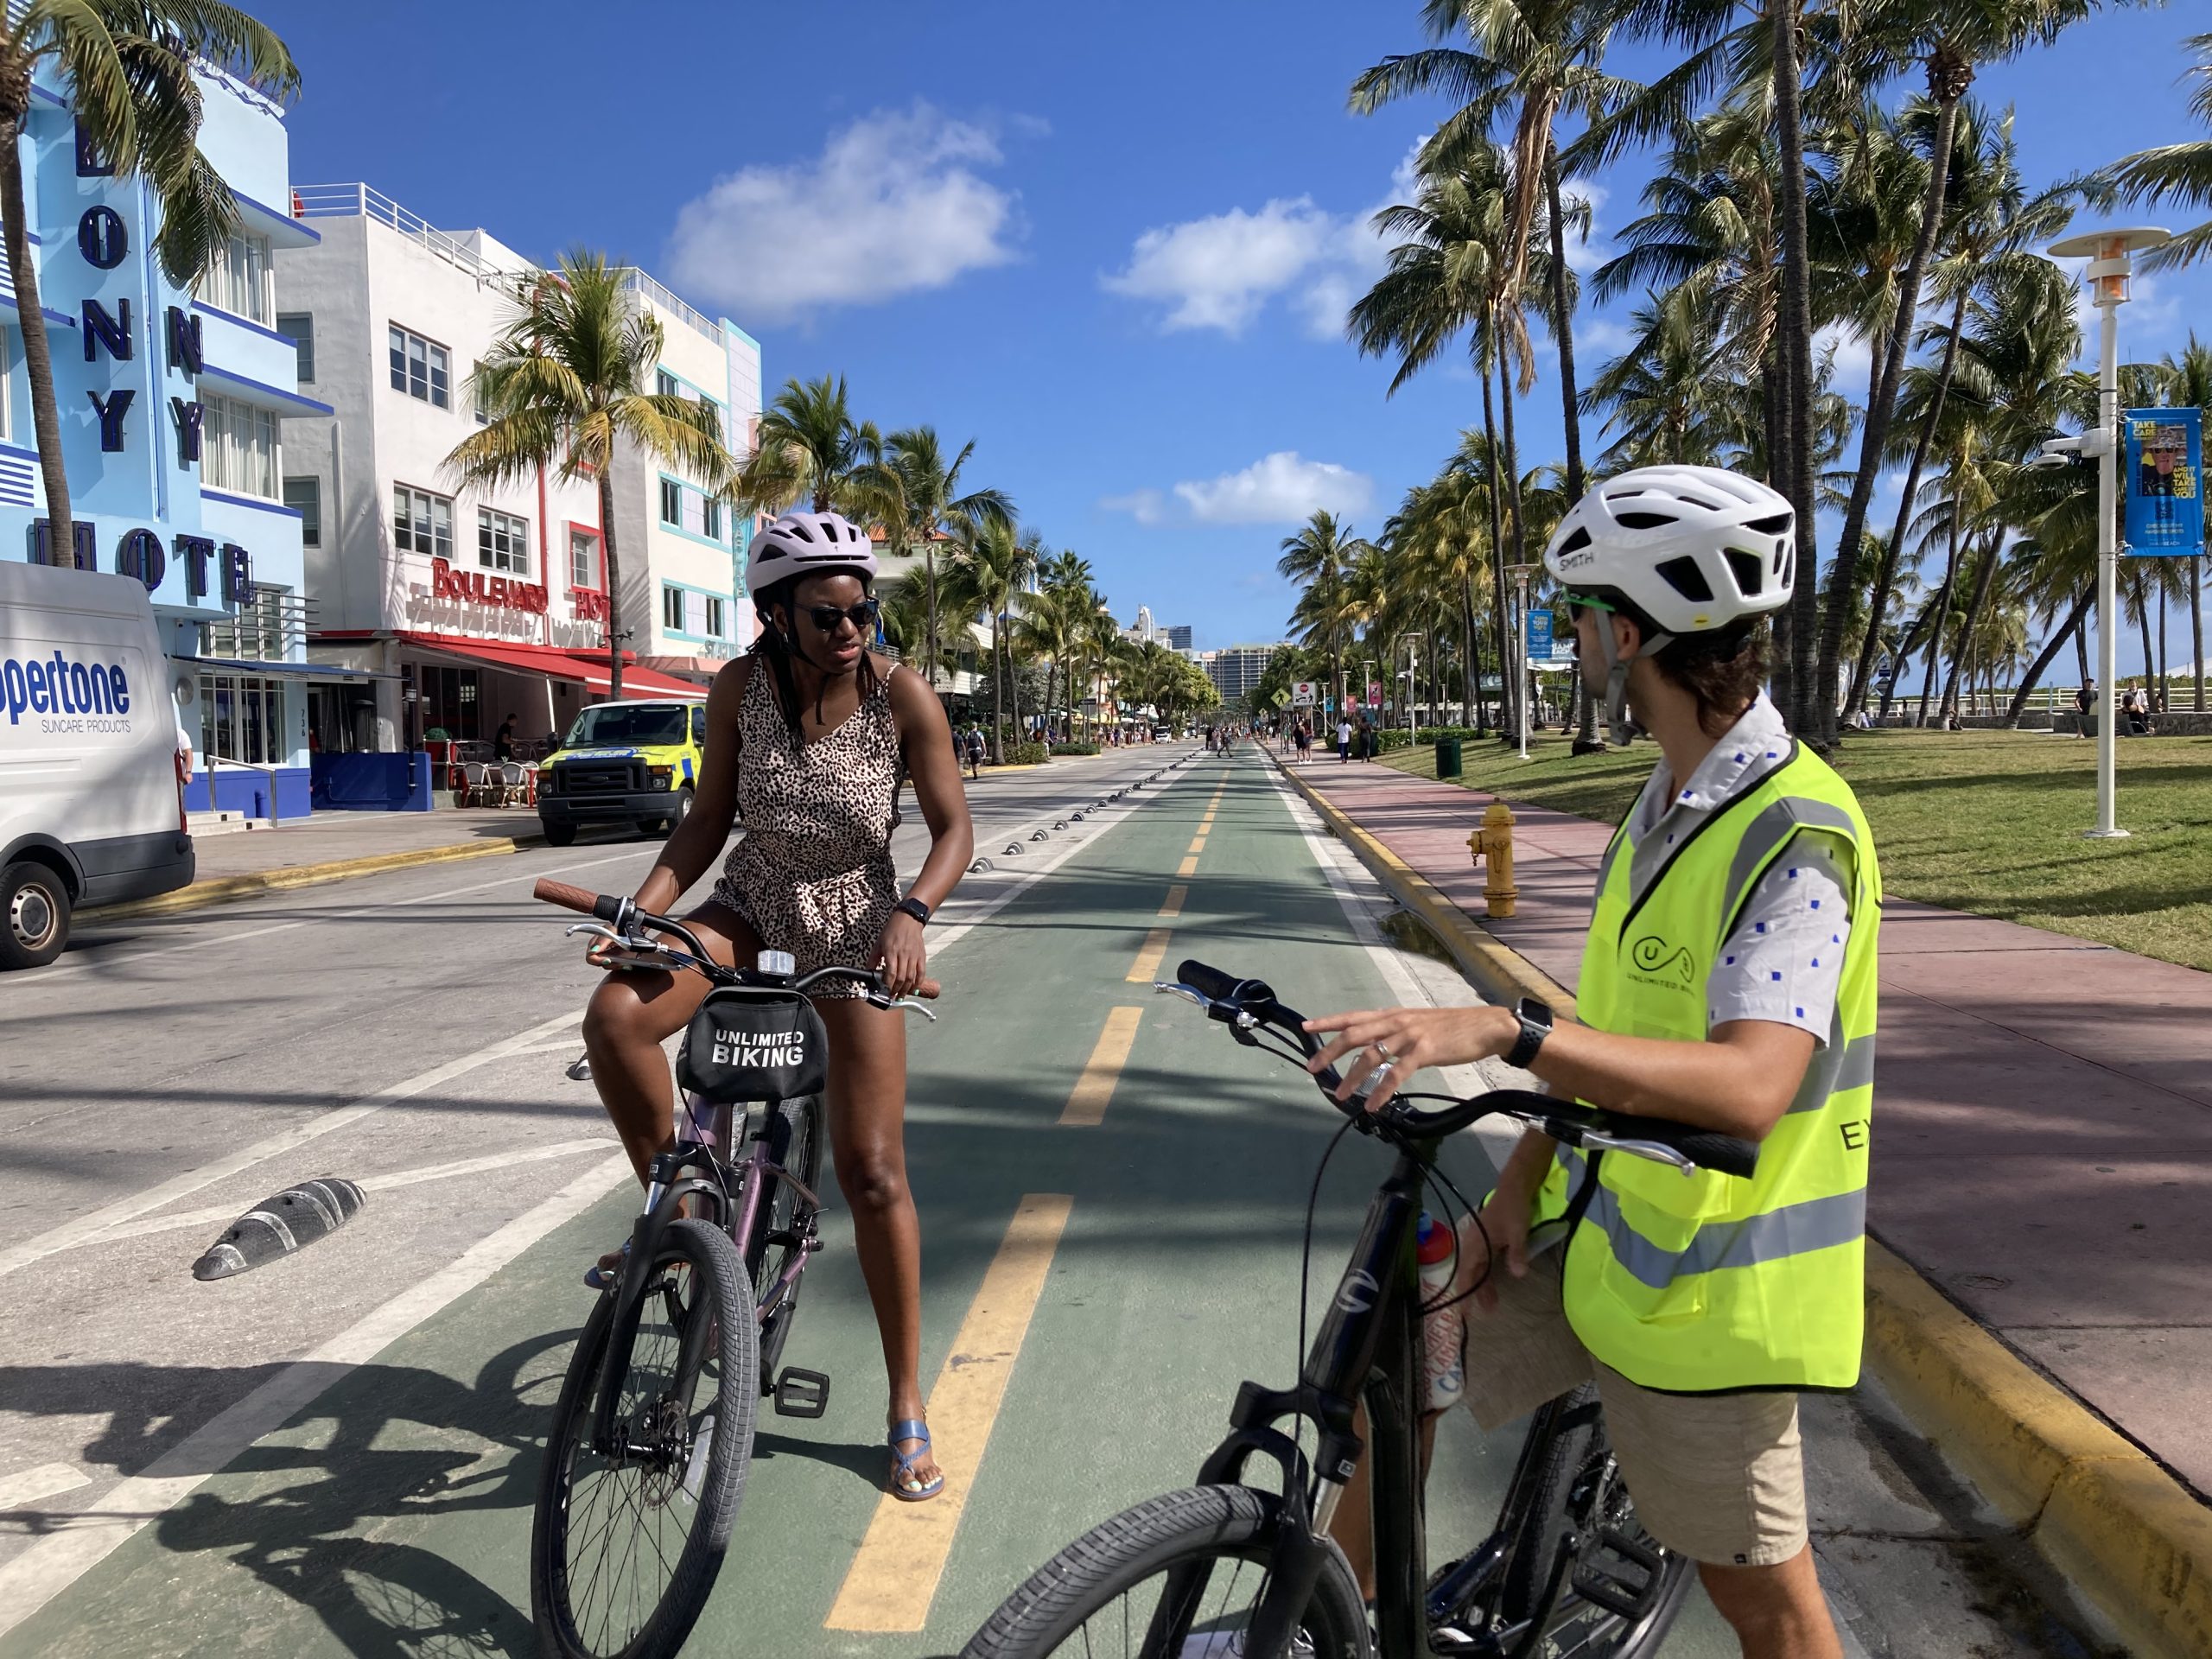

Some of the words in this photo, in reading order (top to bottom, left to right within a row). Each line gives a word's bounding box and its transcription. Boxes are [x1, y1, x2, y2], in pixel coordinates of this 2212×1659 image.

[75, 115, 136, 452] LONY
[1559, 553, 1594, 571] SMITH
[431, 557, 549, 614] BOULEVARD
[575, 591, 610, 622] HOT
[41, 719, 84, 733] SUNCARE
[87, 719, 130, 733] PRODUCTS
[715, 1029, 804, 1046] UNLIMITED
[712, 1044, 804, 1067] BIKING
